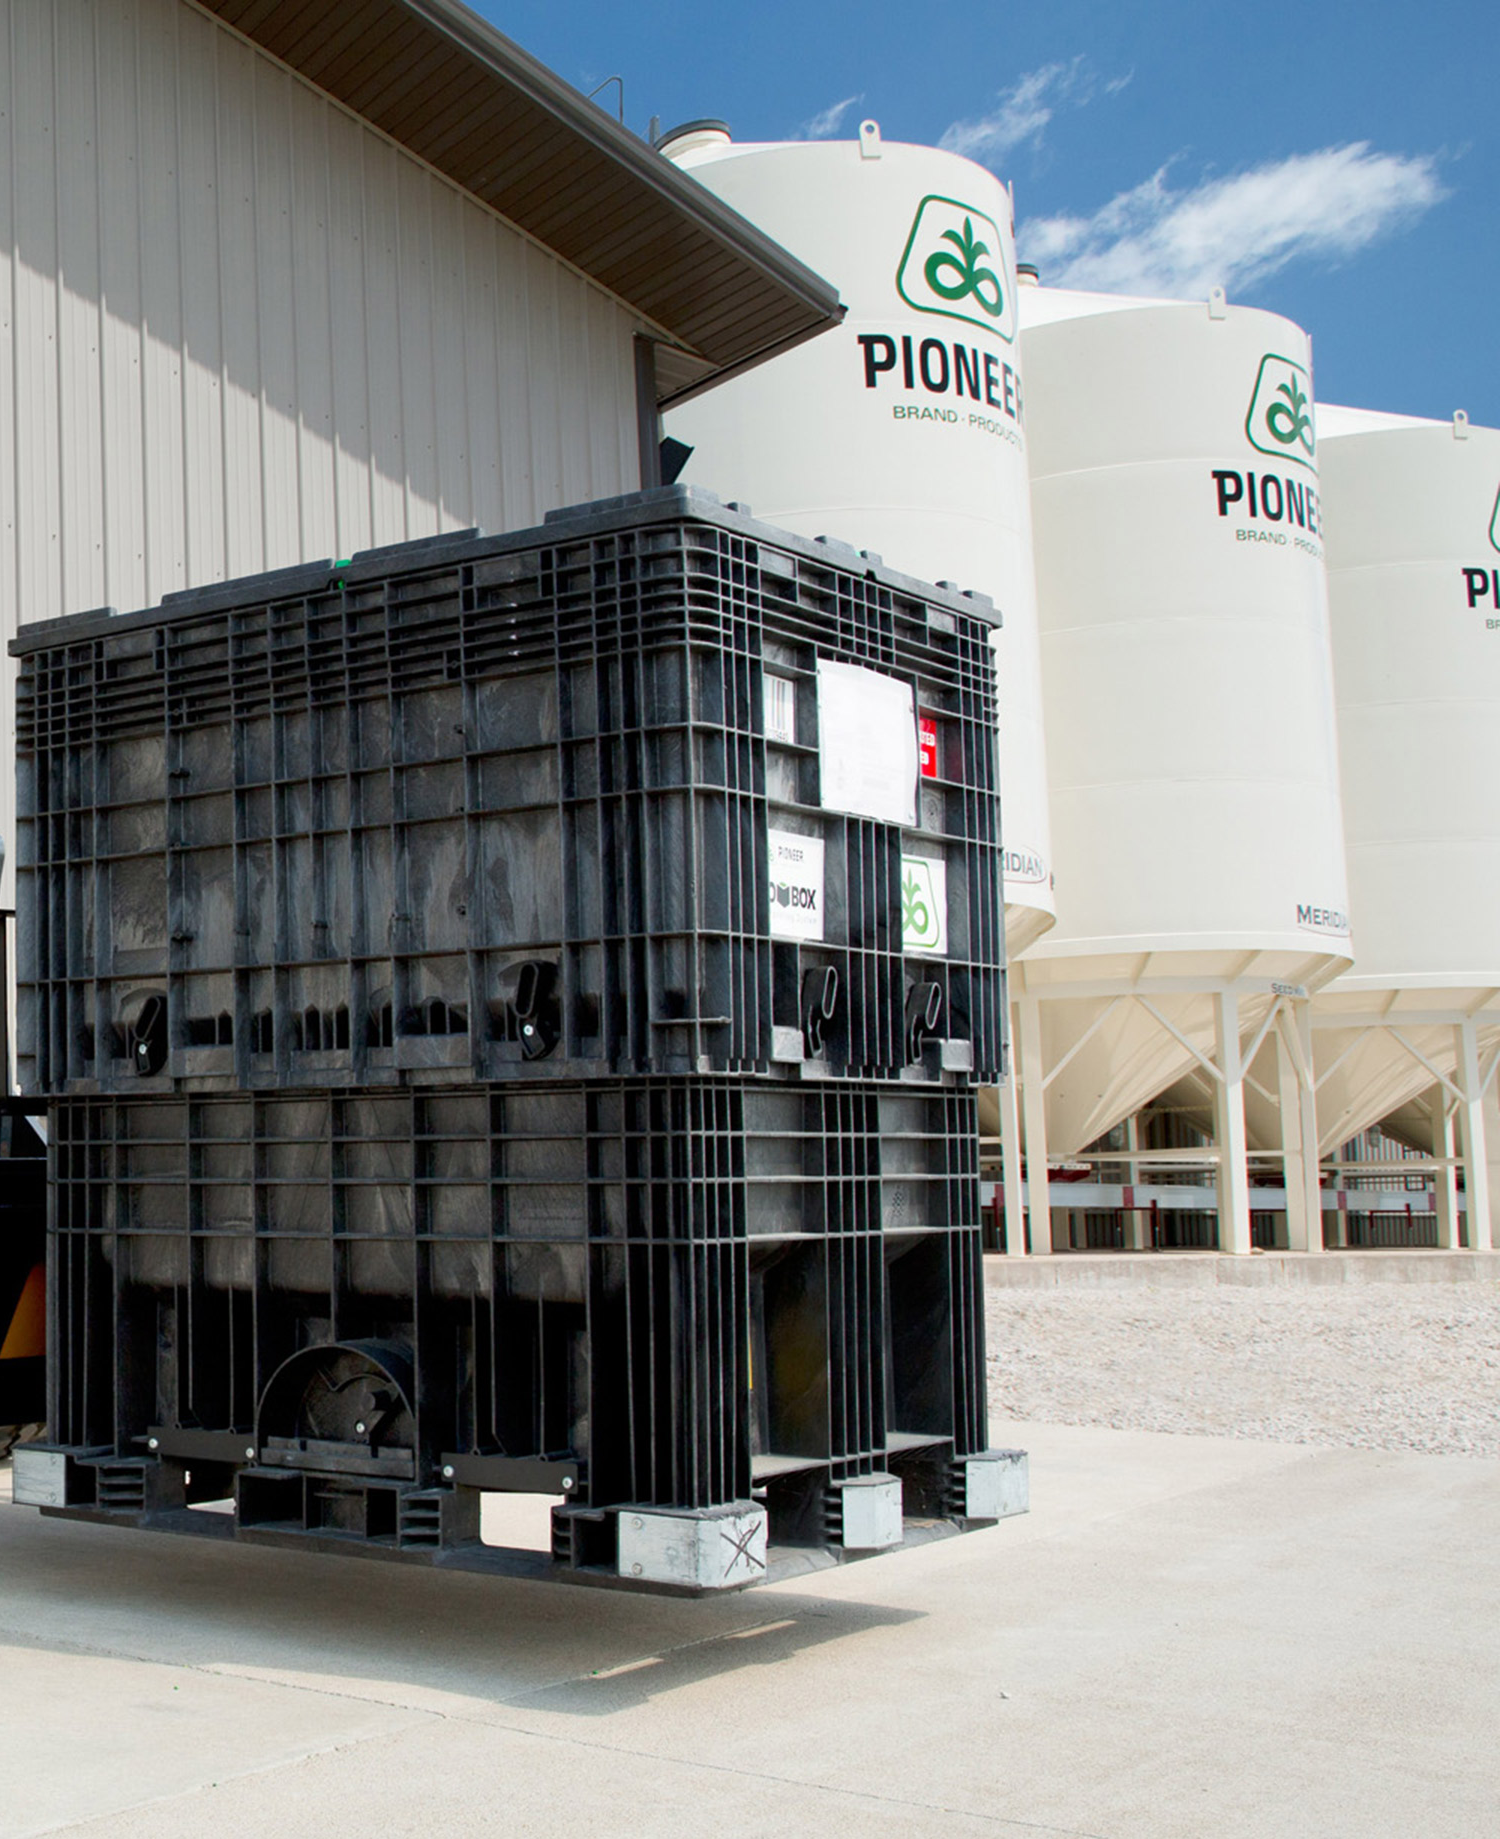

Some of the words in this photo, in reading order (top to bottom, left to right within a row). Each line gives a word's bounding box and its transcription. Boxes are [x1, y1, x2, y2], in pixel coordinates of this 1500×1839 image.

[892, 405, 958, 423] BRAND
[1235, 529, 1287, 546] BRAND
[791, 886, 817, 910] BOX
